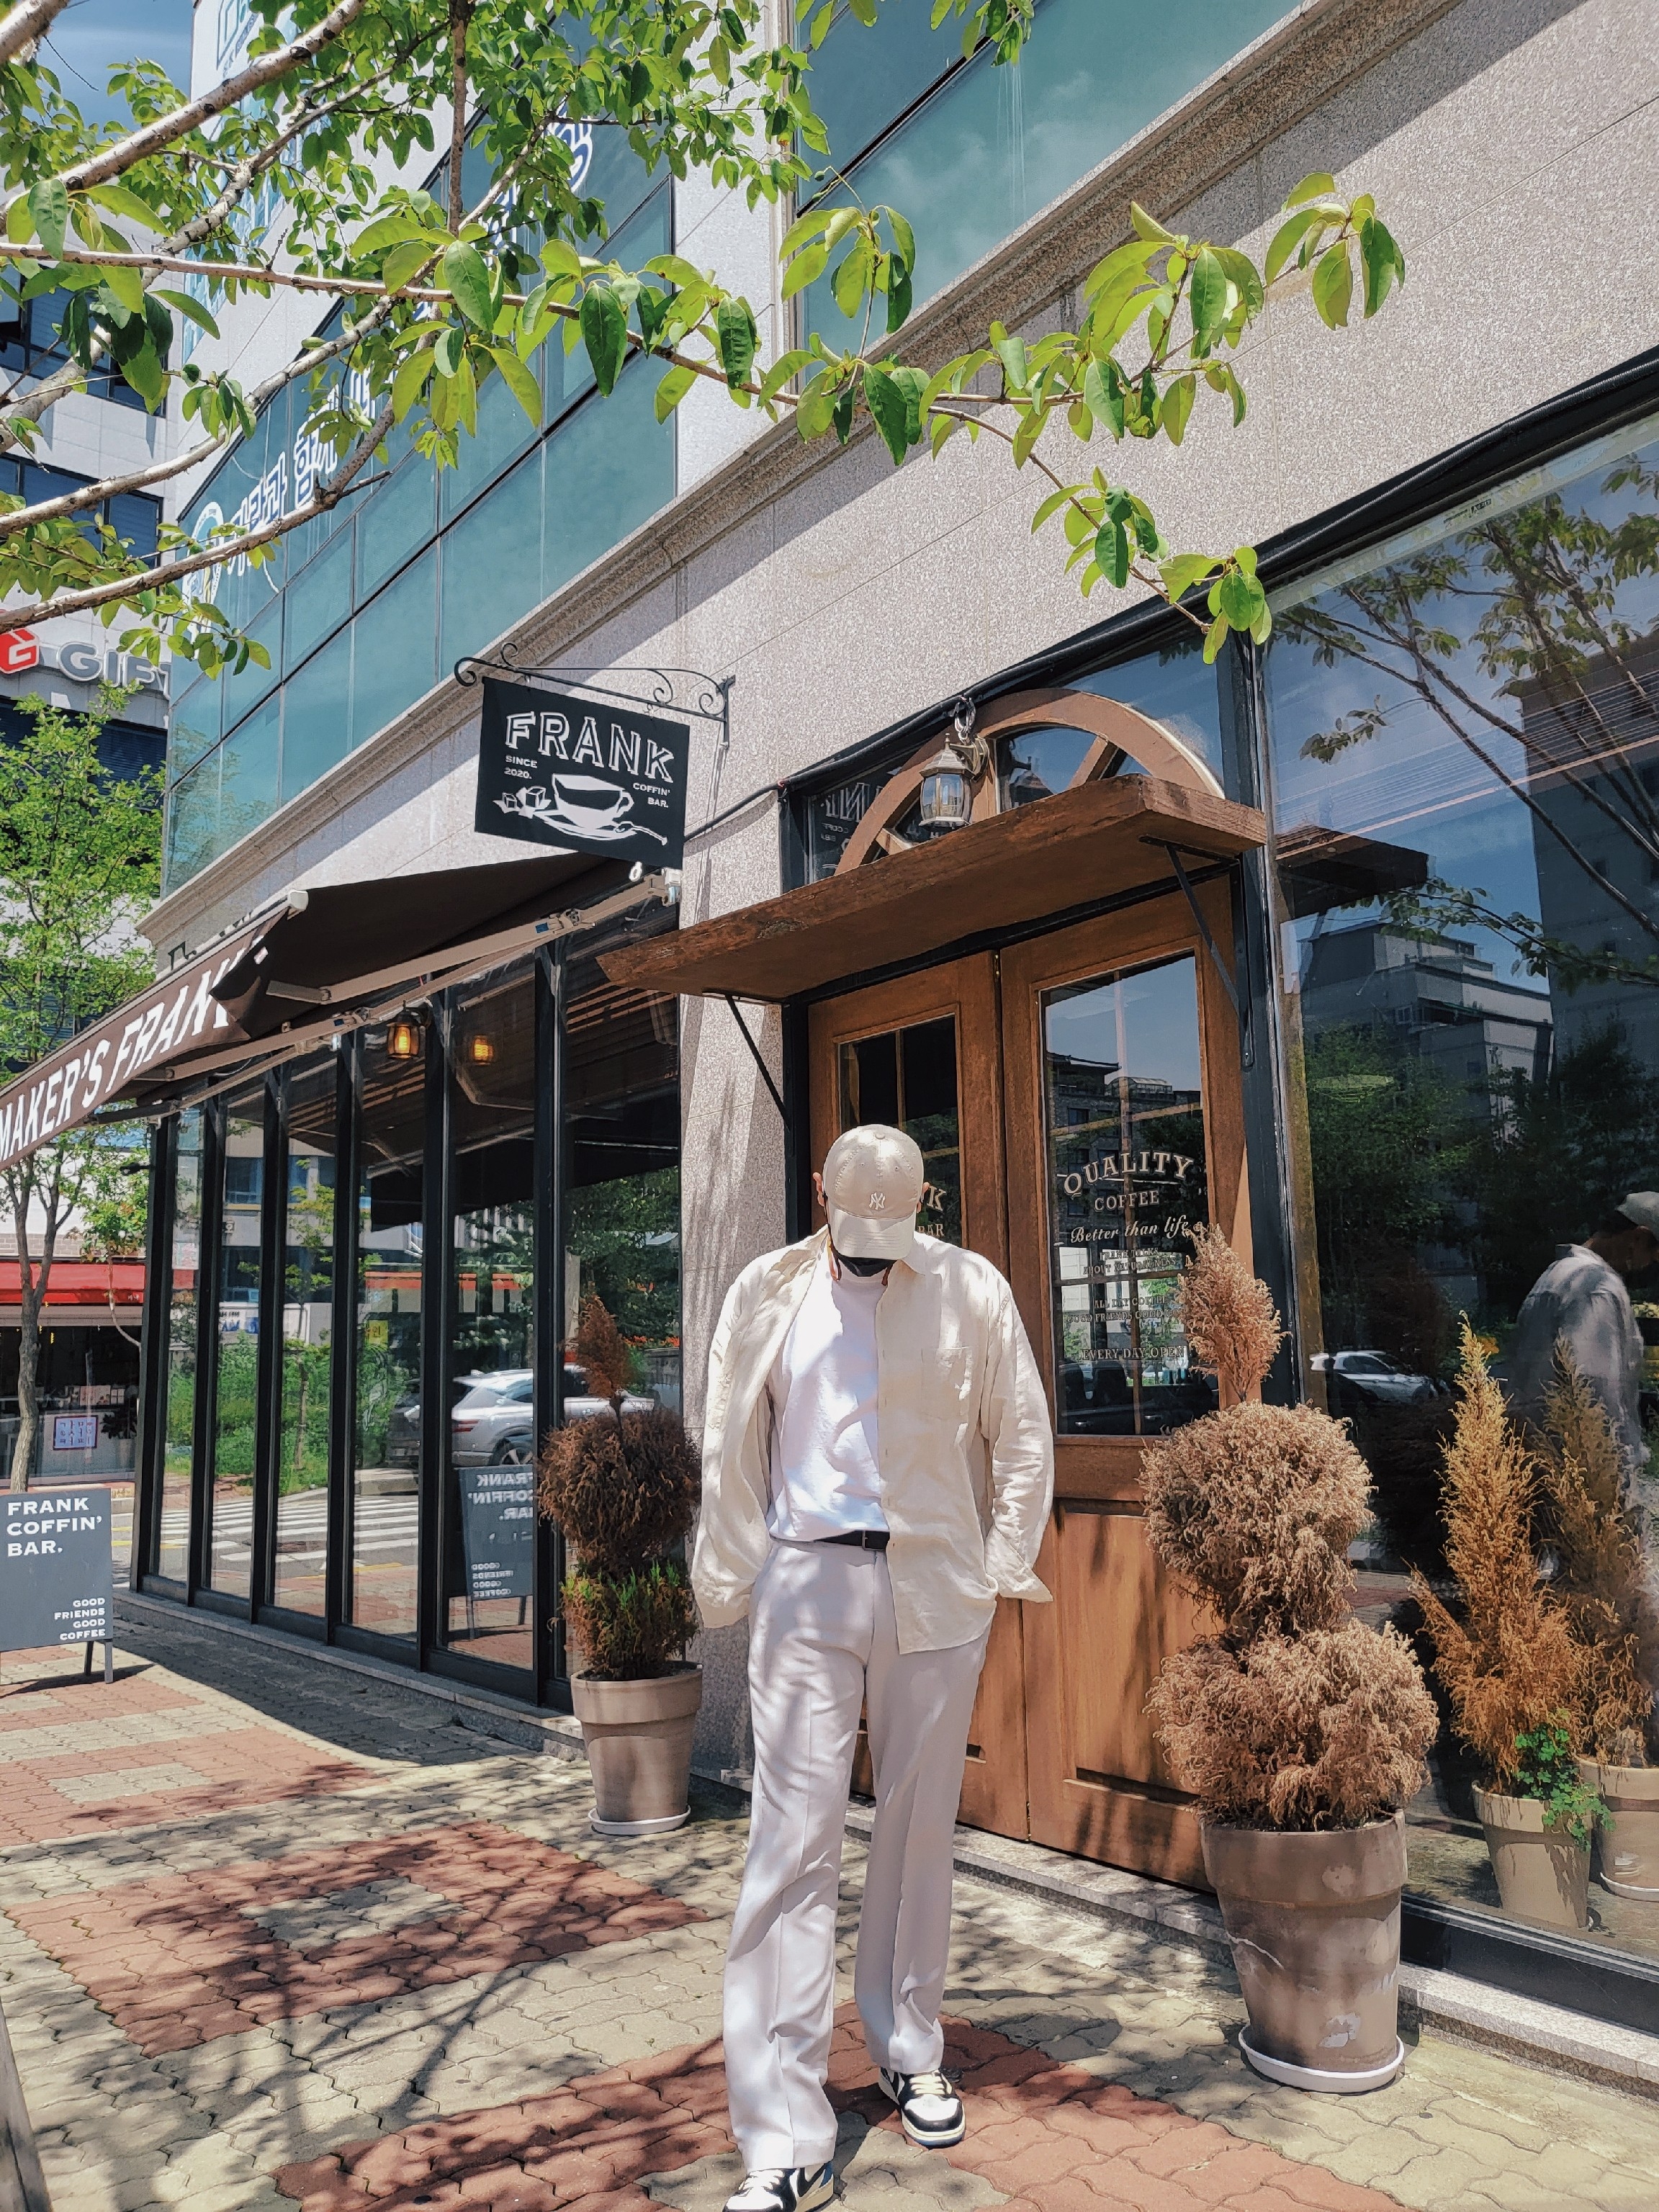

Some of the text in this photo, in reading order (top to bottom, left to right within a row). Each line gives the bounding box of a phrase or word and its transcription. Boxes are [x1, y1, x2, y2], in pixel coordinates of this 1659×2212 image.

[505, 711, 675, 783] FRANK
[505, 755, 538, 768] SINCE
[504, 767, 532, 780] 2020.
[647, 797, 669, 808] BAR.
[1064, 1151, 1193, 1200] QUALITY
[869, 1192, 886, 1210] NY
[1094, 1190, 1159, 1212] COFFEE
[1070, 1214, 1190, 1244] Better than life
[1094, 1299, 1110, 1309] ALL
[1082, 1345, 1185, 1361] EVERY DAY OPEN
[8, 1497, 90, 1516] FRANK
[6, 1516, 102, 1536] COFFIN'
[7, 1541, 63, 1557] BAR.
[73, 1598, 105, 1608] GOOD
[54, 1607, 105, 1620] FRIENDS
[73, 1618, 106, 1629] GOOD
[60, 1629, 106, 1641] COFFEE
